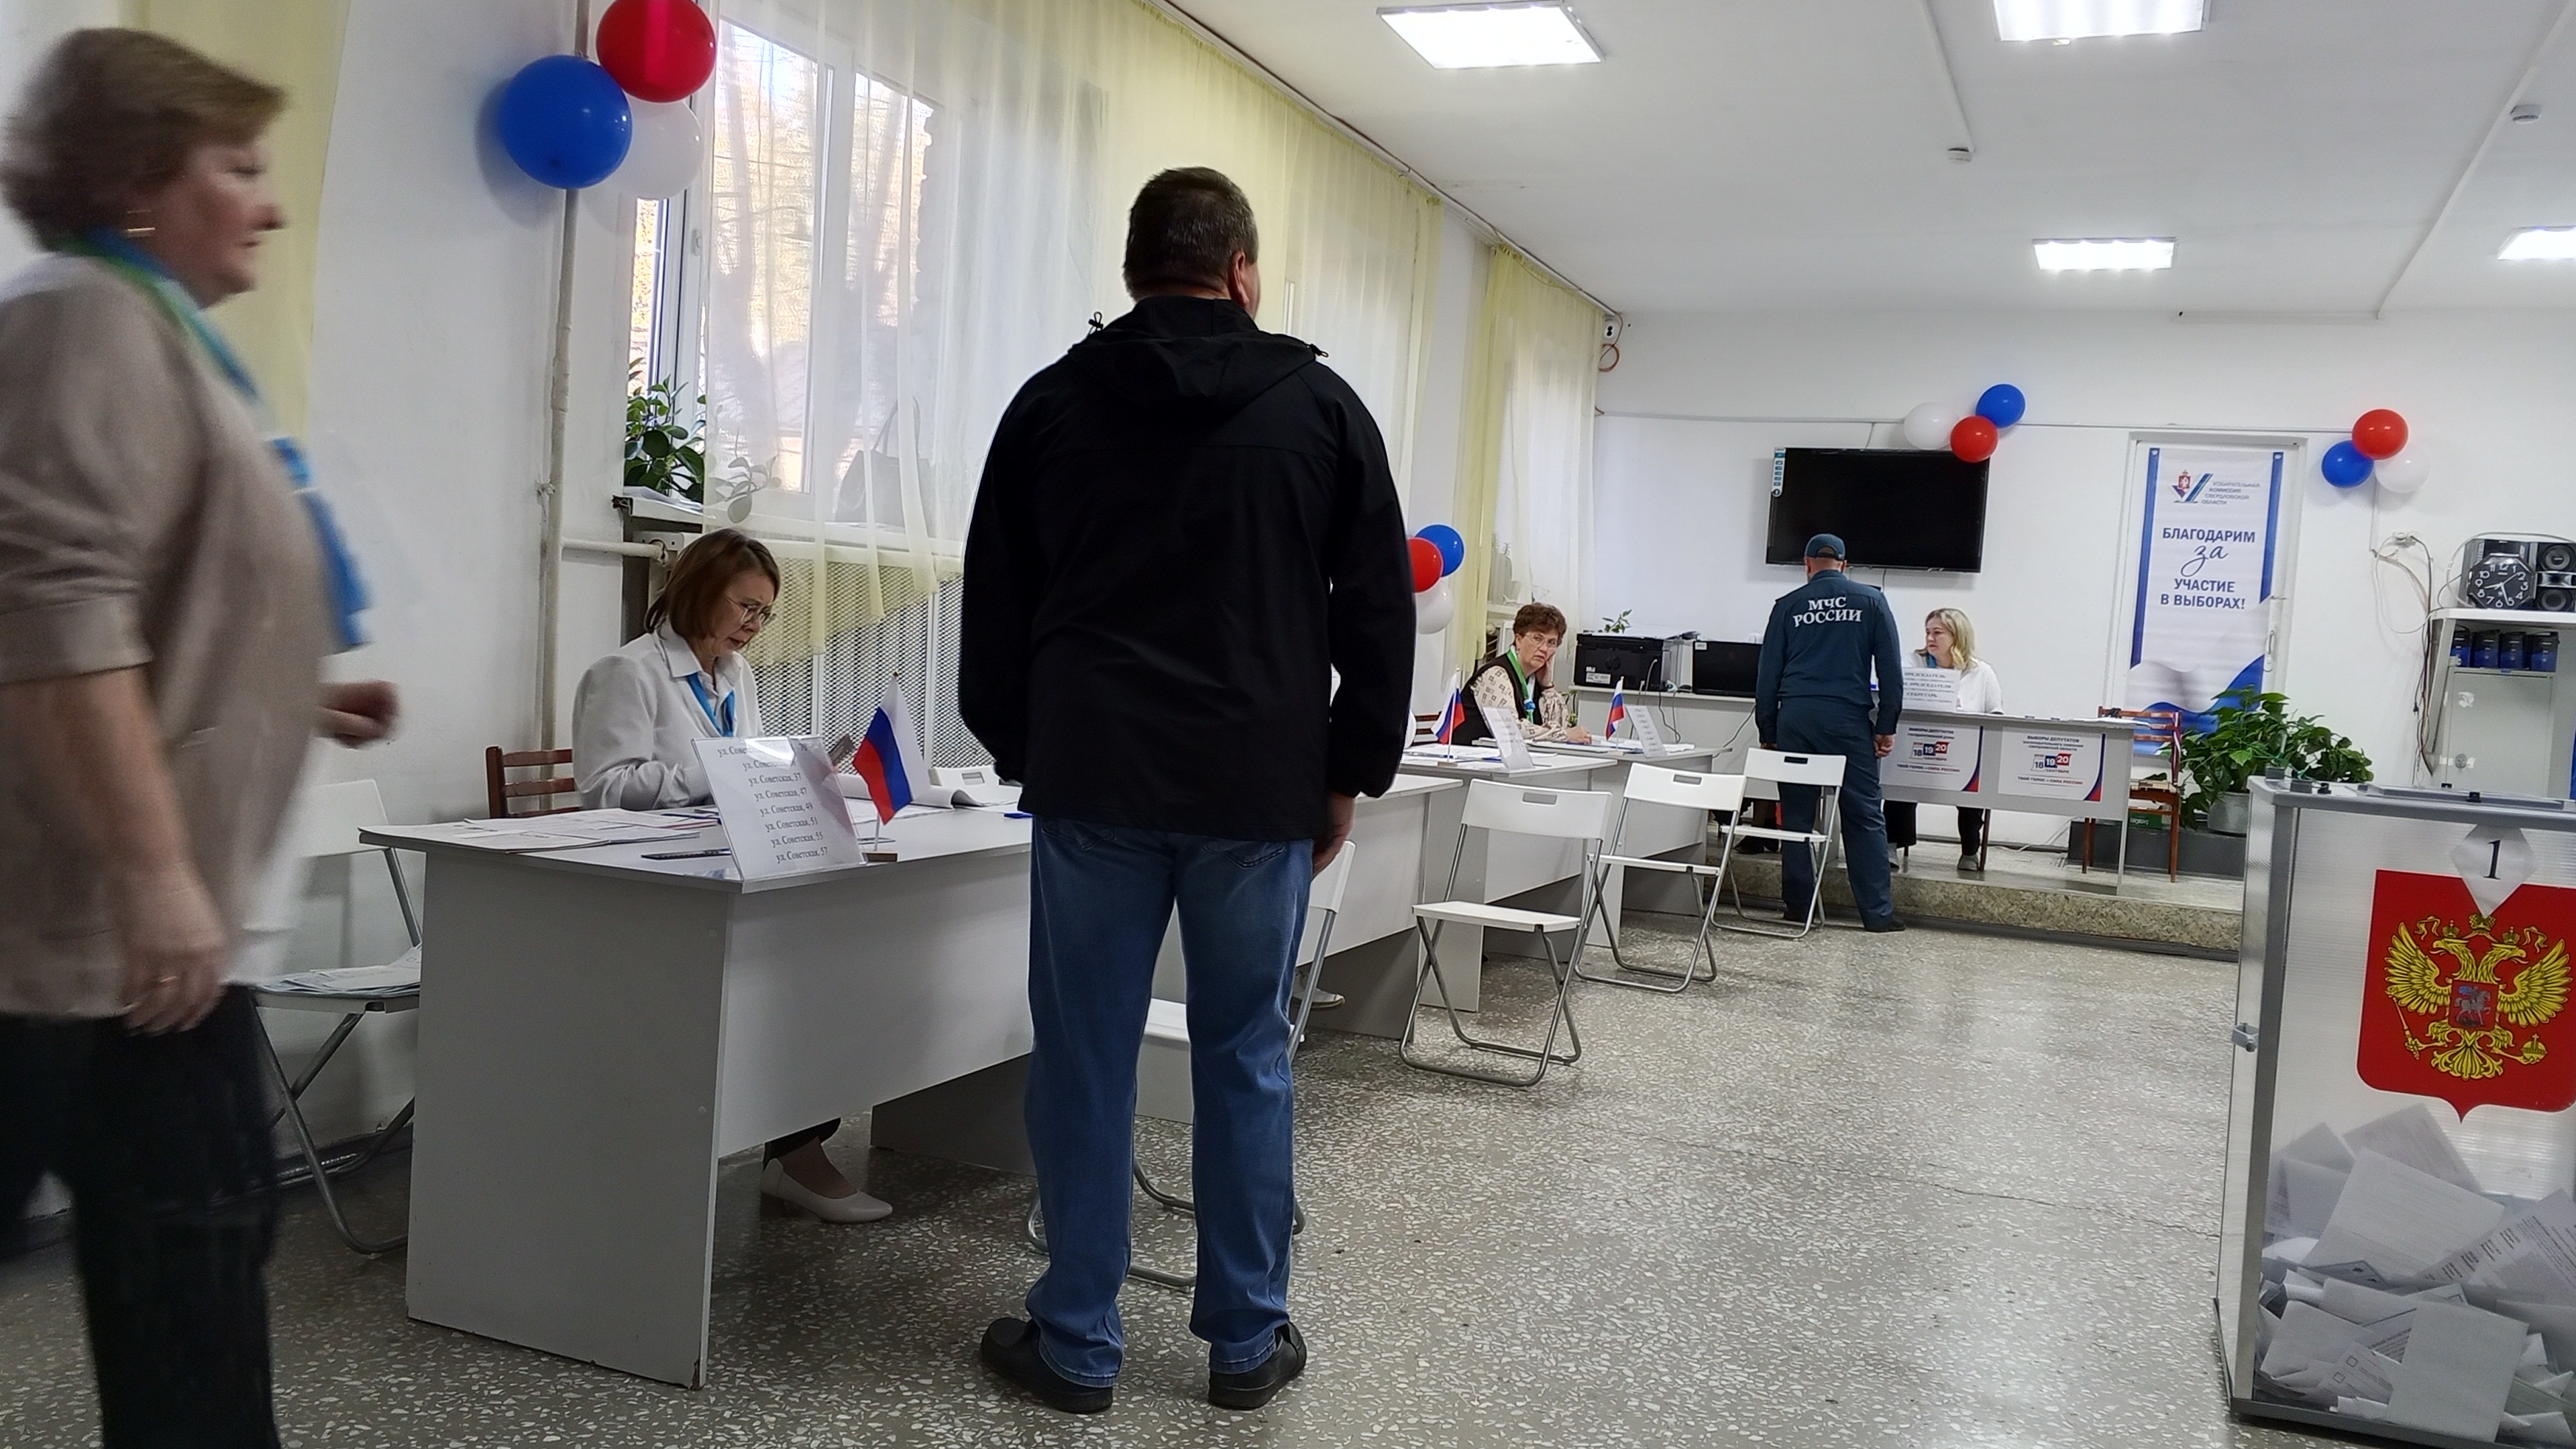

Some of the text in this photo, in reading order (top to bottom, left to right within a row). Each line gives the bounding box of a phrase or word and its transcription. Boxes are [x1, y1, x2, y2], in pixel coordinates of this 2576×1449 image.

[2162, 527, 2256, 543] БЛАГОДАРИМ
[2180, 545, 2229, 578] за
[2512, 565, 2517, 573] 1
[2518, 572, 2526, 580] 2
[2174, 578, 2236, 593] УЧАСТИЕ
[2475, 579, 2483, 588] 9
[2520, 582, 2528, 590] 3
[2477, 589, 2485, 598] 8
[2515, 591, 2524, 600] 4
[1808, 596, 1847, 611] МЧС
[2160, 594, 2245, 609] В ВЫБОРАХ!
[2486, 596, 2495, 604] 7
[2495, 600, 2503, 608] 6
[2508, 597, 2515, 606] 5
[1792, 609, 1863, 627] РОССИИ
[2046, 758, 2055, 766] 19
[2483, 839, 2501, 880] 1
